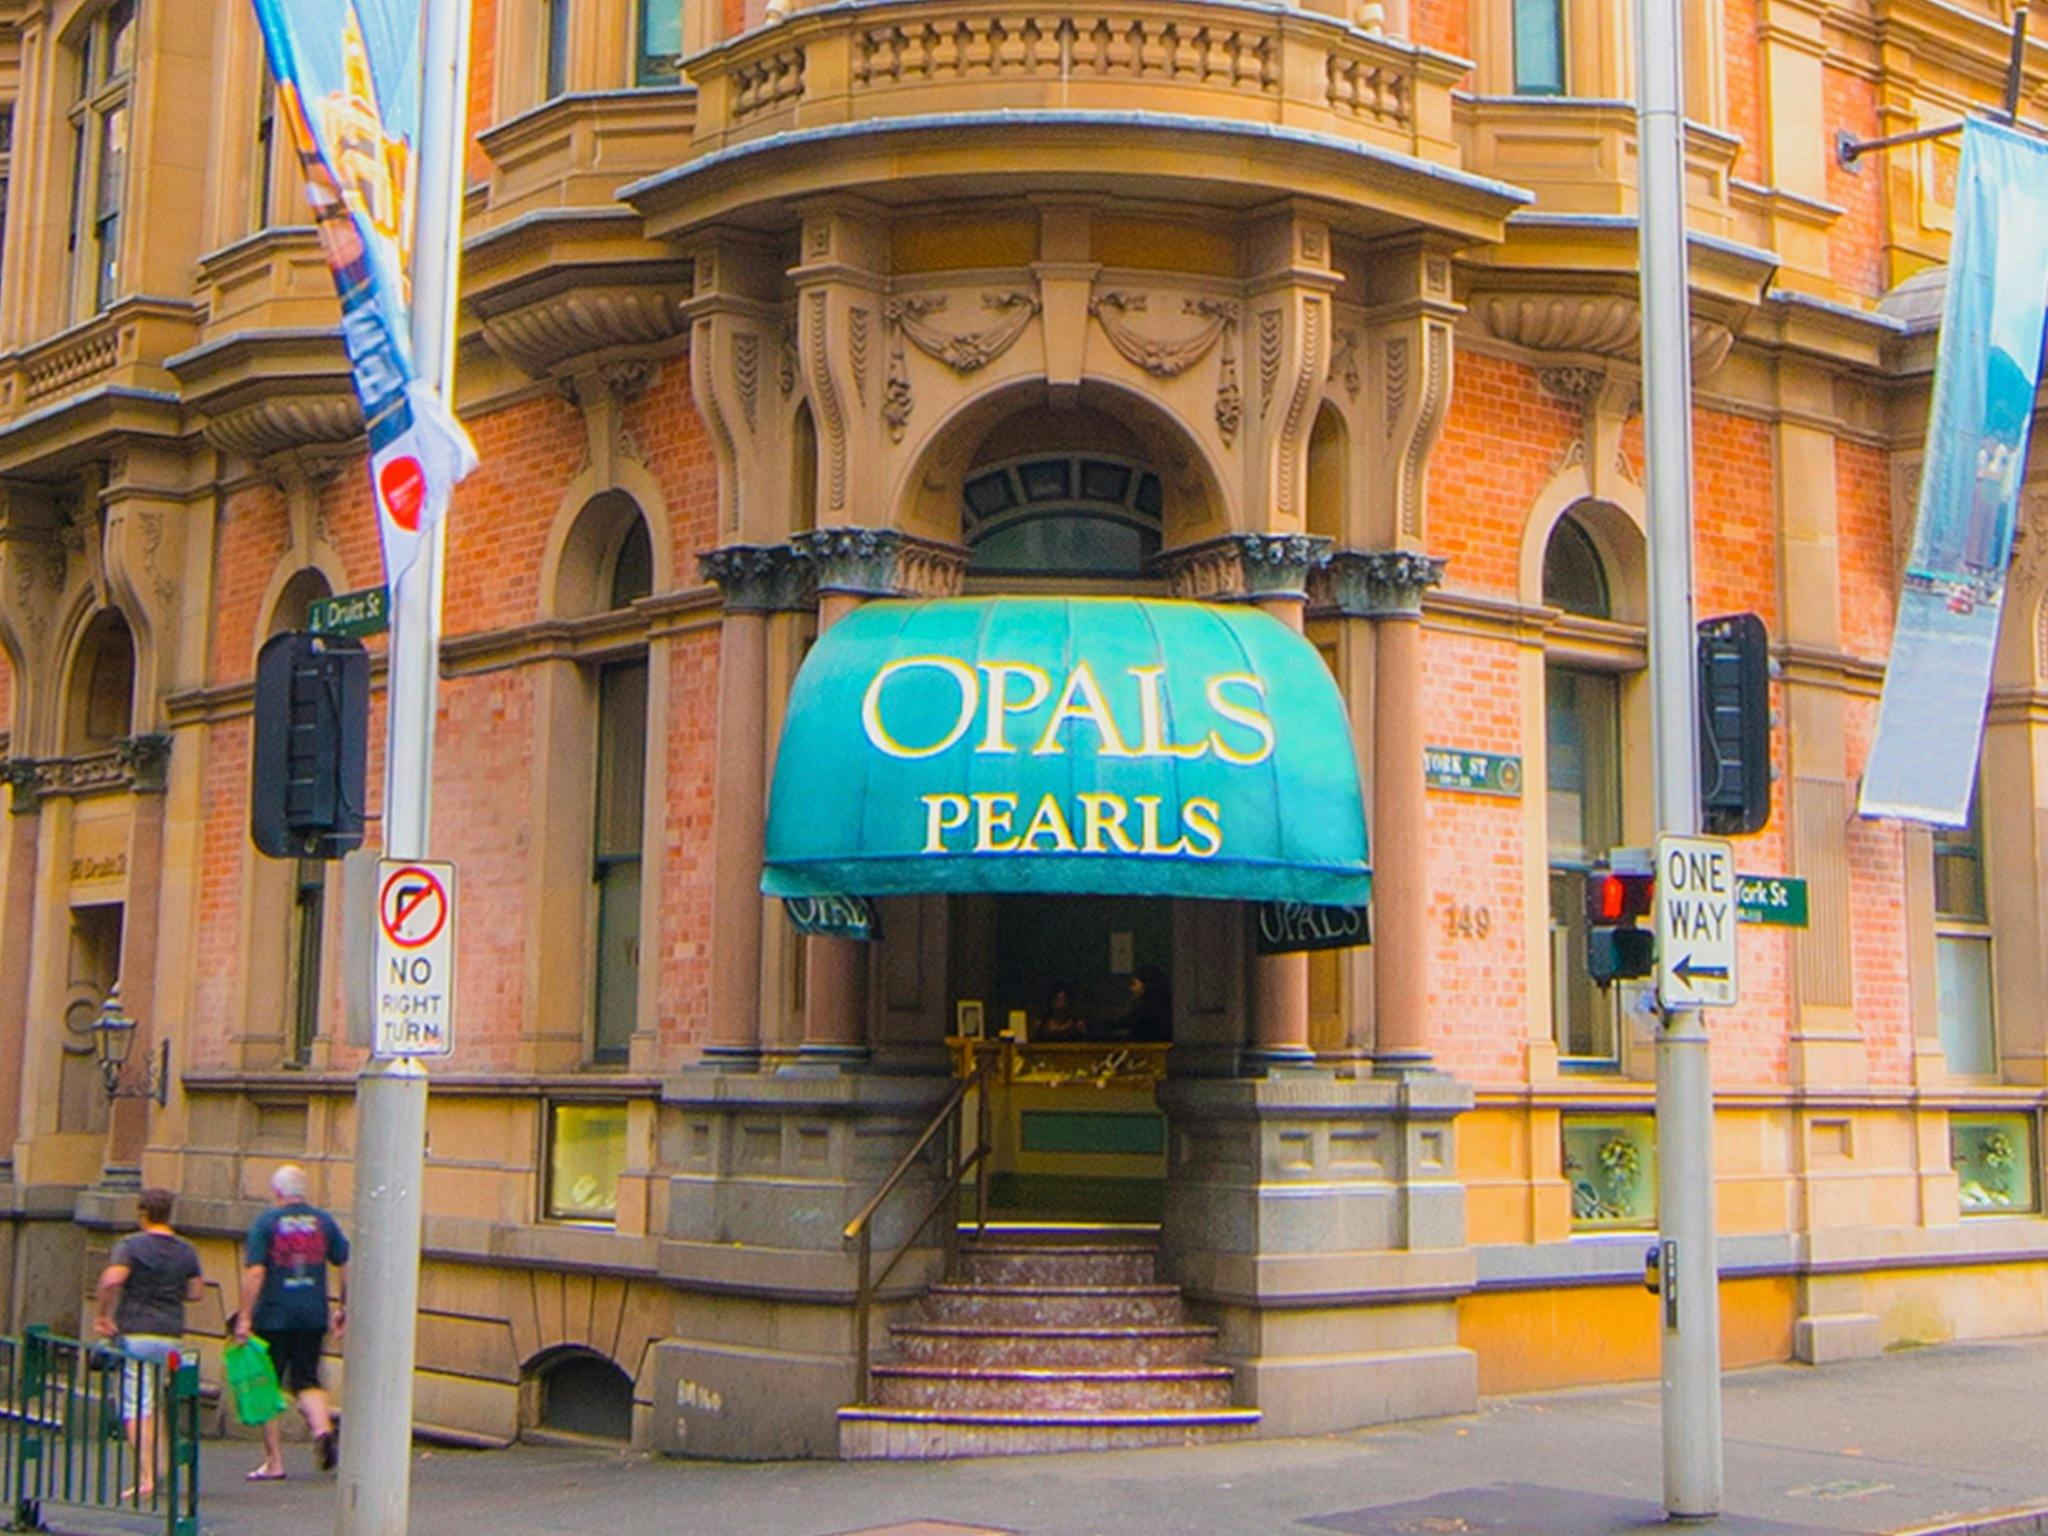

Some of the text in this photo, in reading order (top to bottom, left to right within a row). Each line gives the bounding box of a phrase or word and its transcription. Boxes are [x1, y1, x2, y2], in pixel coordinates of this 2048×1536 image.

[861, 655, 1277, 766] OPALS
[1468, 756, 1489, 779] ST
[921, 792, 1224, 858] PEARLS
[1668, 849, 1726, 894] ONE
[1769, 880, 1789, 908] St
[1667, 899, 1728, 942] WAY
[389, 956, 432, 986] NO
[382, 993, 442, 1015] RIGHT
[384, 1021, 440, 1043] TURN
